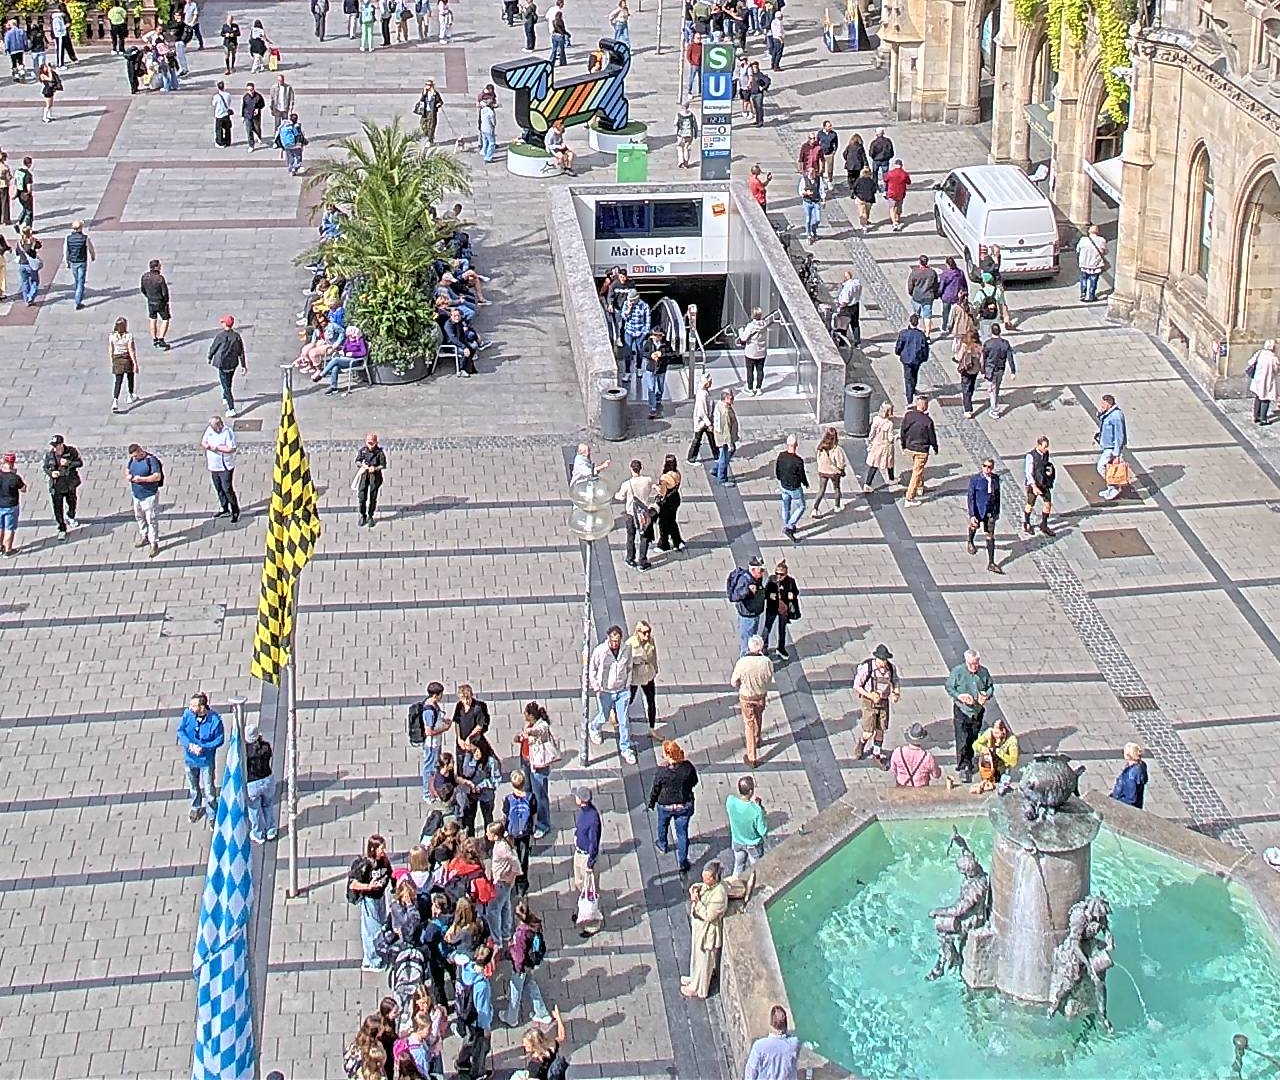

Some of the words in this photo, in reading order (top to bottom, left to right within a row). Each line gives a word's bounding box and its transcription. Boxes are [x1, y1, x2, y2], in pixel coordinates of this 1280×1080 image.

[710, 47, 727, 69] S
[709, 75, 726, 97] U
[611, 244, 686, 258] Marienplatz
